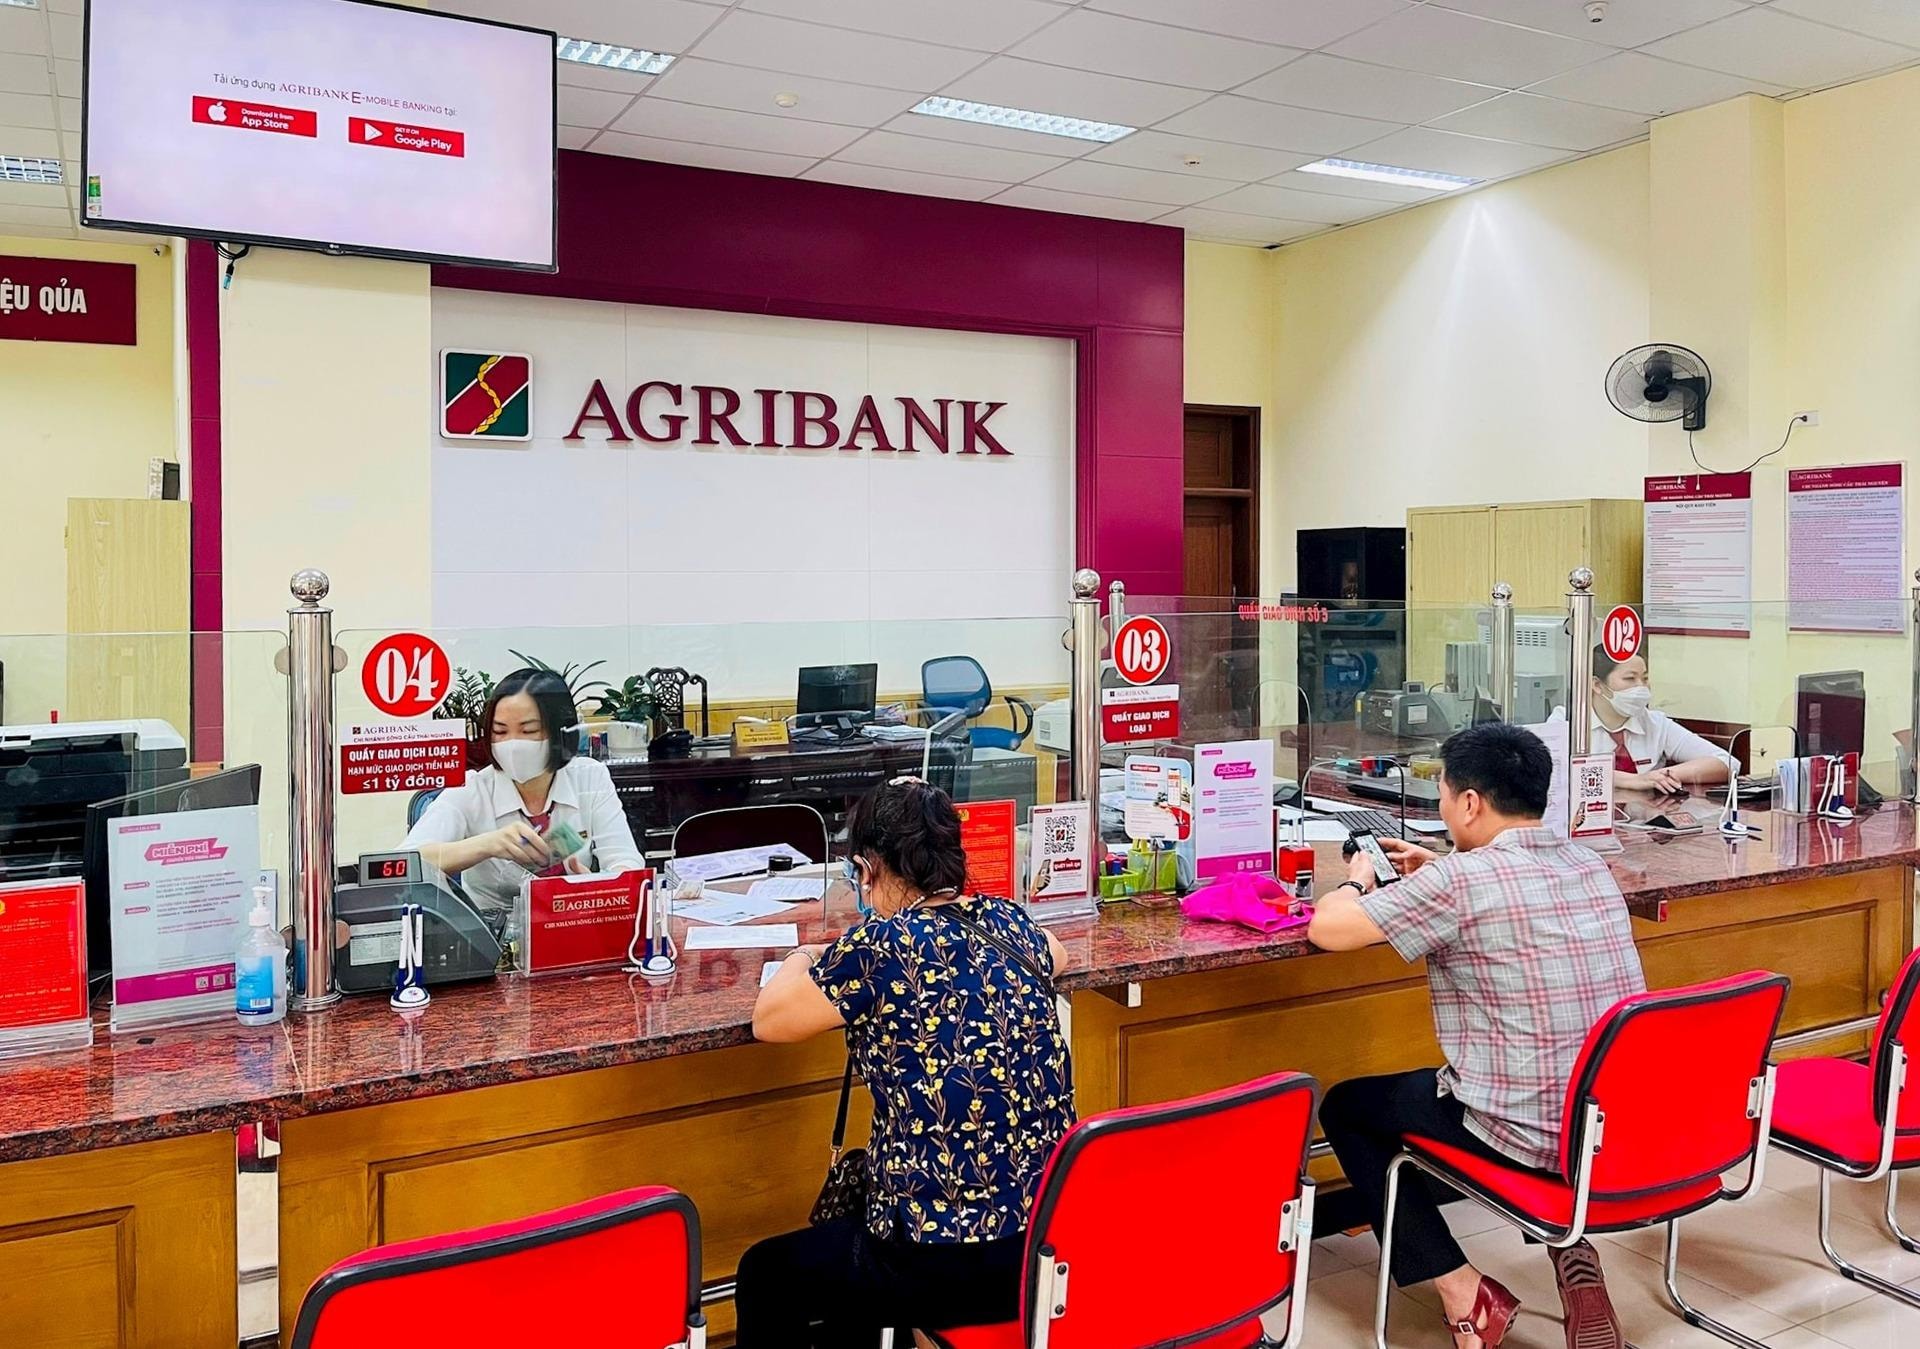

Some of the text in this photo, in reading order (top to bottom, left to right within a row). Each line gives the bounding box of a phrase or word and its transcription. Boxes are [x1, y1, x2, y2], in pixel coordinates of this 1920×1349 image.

[214, 73, 228, 84] Tải
[230, 76, 249, 88] ứng
[251, 79, 276, 92] dụng
[279, 83, 349, 101] AGRIBANK
[402, 101, 442, 114] BANKING
[241, 108, 273, 118] Download
[241, 115, 289, 130] App Store
[394, 133, 452, 153] Google Play
[561, 378, 1016, 456] AGRIBANK
[1262, 605, 1281, 620] GIAO
[1307, 602, 1320, 623] SỐ
[1321, 607, 1329, 623] 5
[1609, 616, 1636, 653] 02
[1122, 629, 1161, 672] 03
[376, 646, 439, 704] 04
[1133, 712, 1151, 721] GIAO
[1152, 711, 1170, 721] DỊCH
[363, 724, 418, 735] AGRIBANK
[1129, 724, 1152, 734] LOẠI 1
[378, 749, 400, 760] GIAO
[403, 747, 426, 760] DỊCH
[428, 746, 450, 759] LOẠI
[452, 746, 458, 755] 2
[348, 766, 364, 776] HẠN
[366, 763, 383, 774] MỨC
[385, 764, 404, 773] GIAO
[405, 763, 424, 773] DỊCH
[444, 760, 460, 770] MẶT
[385, 775, 400, 790] tỷ
[405, 773, 446, 788] đồng
[152, 841, 209, 857] MIỄN PHÍ
[383, 860, 406, 876] 60
[566, 895, 630, 911] AGRIBANK
